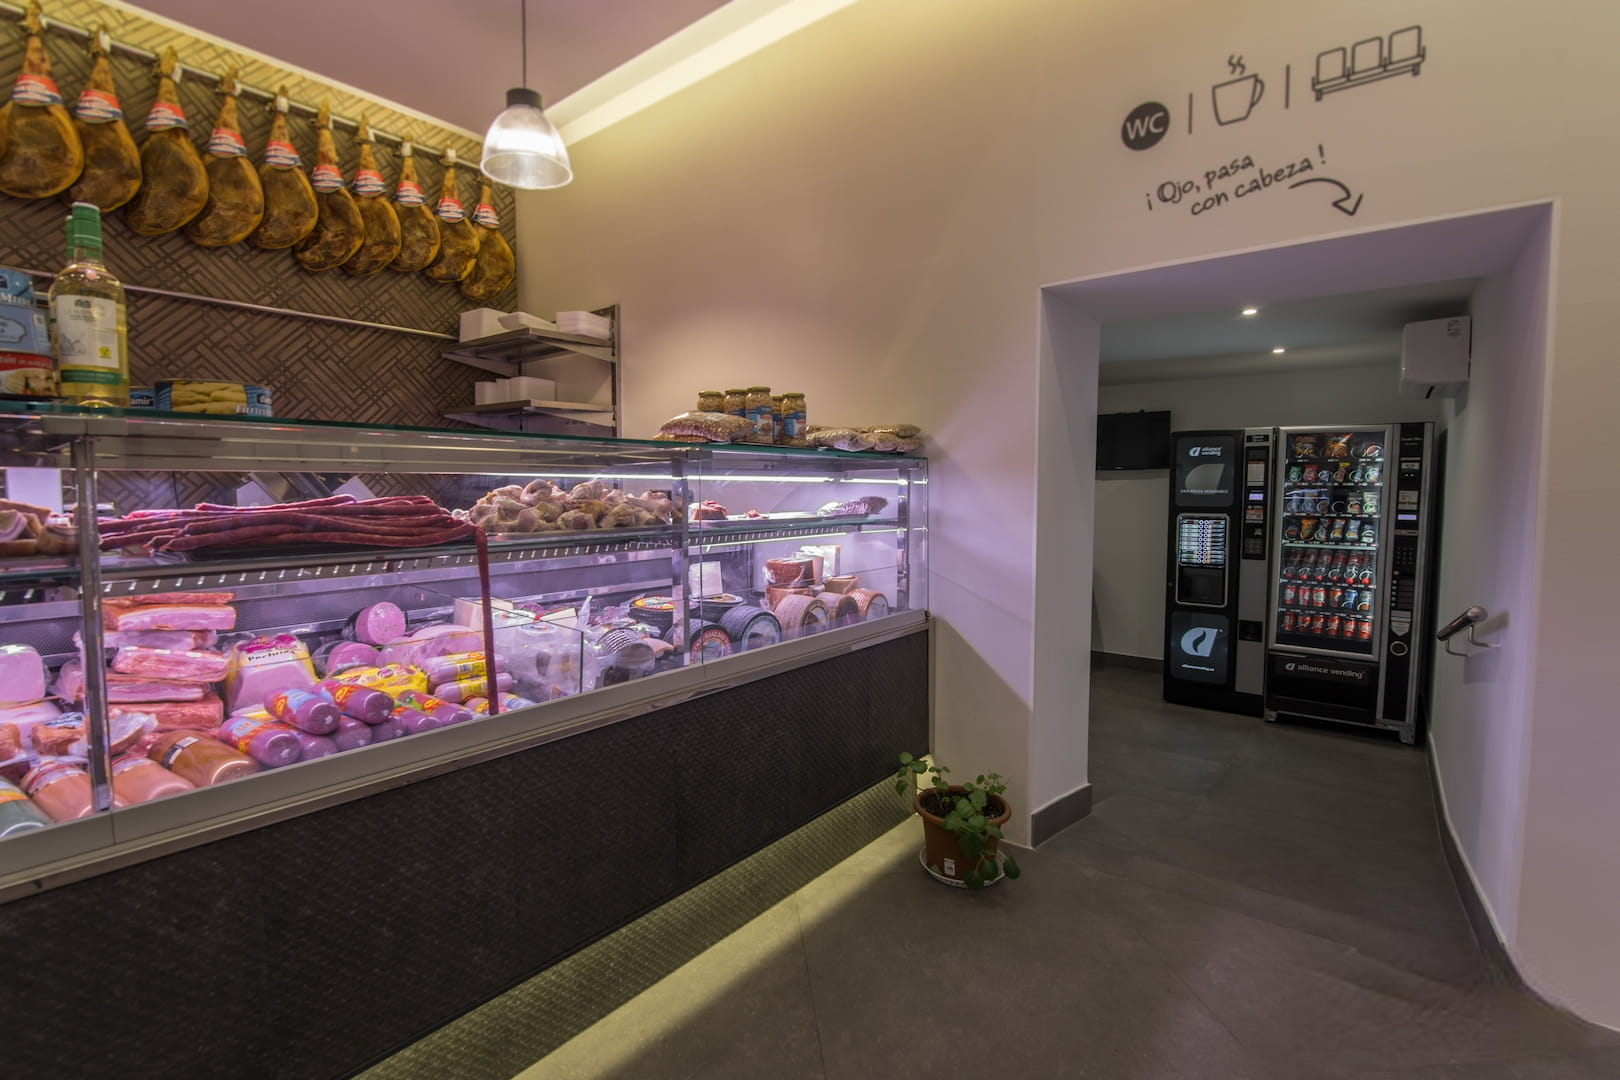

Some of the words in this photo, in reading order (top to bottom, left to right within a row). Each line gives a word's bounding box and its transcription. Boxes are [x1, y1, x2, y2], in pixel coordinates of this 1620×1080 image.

[1125, 112, 1165, 141] WC
[1203, 154, 1255, 189] pasa
[1190, 188, 1229, 216] con
[1297, 663, 1329, 674] alliance
[1330, 668, 1365, 680] vending
